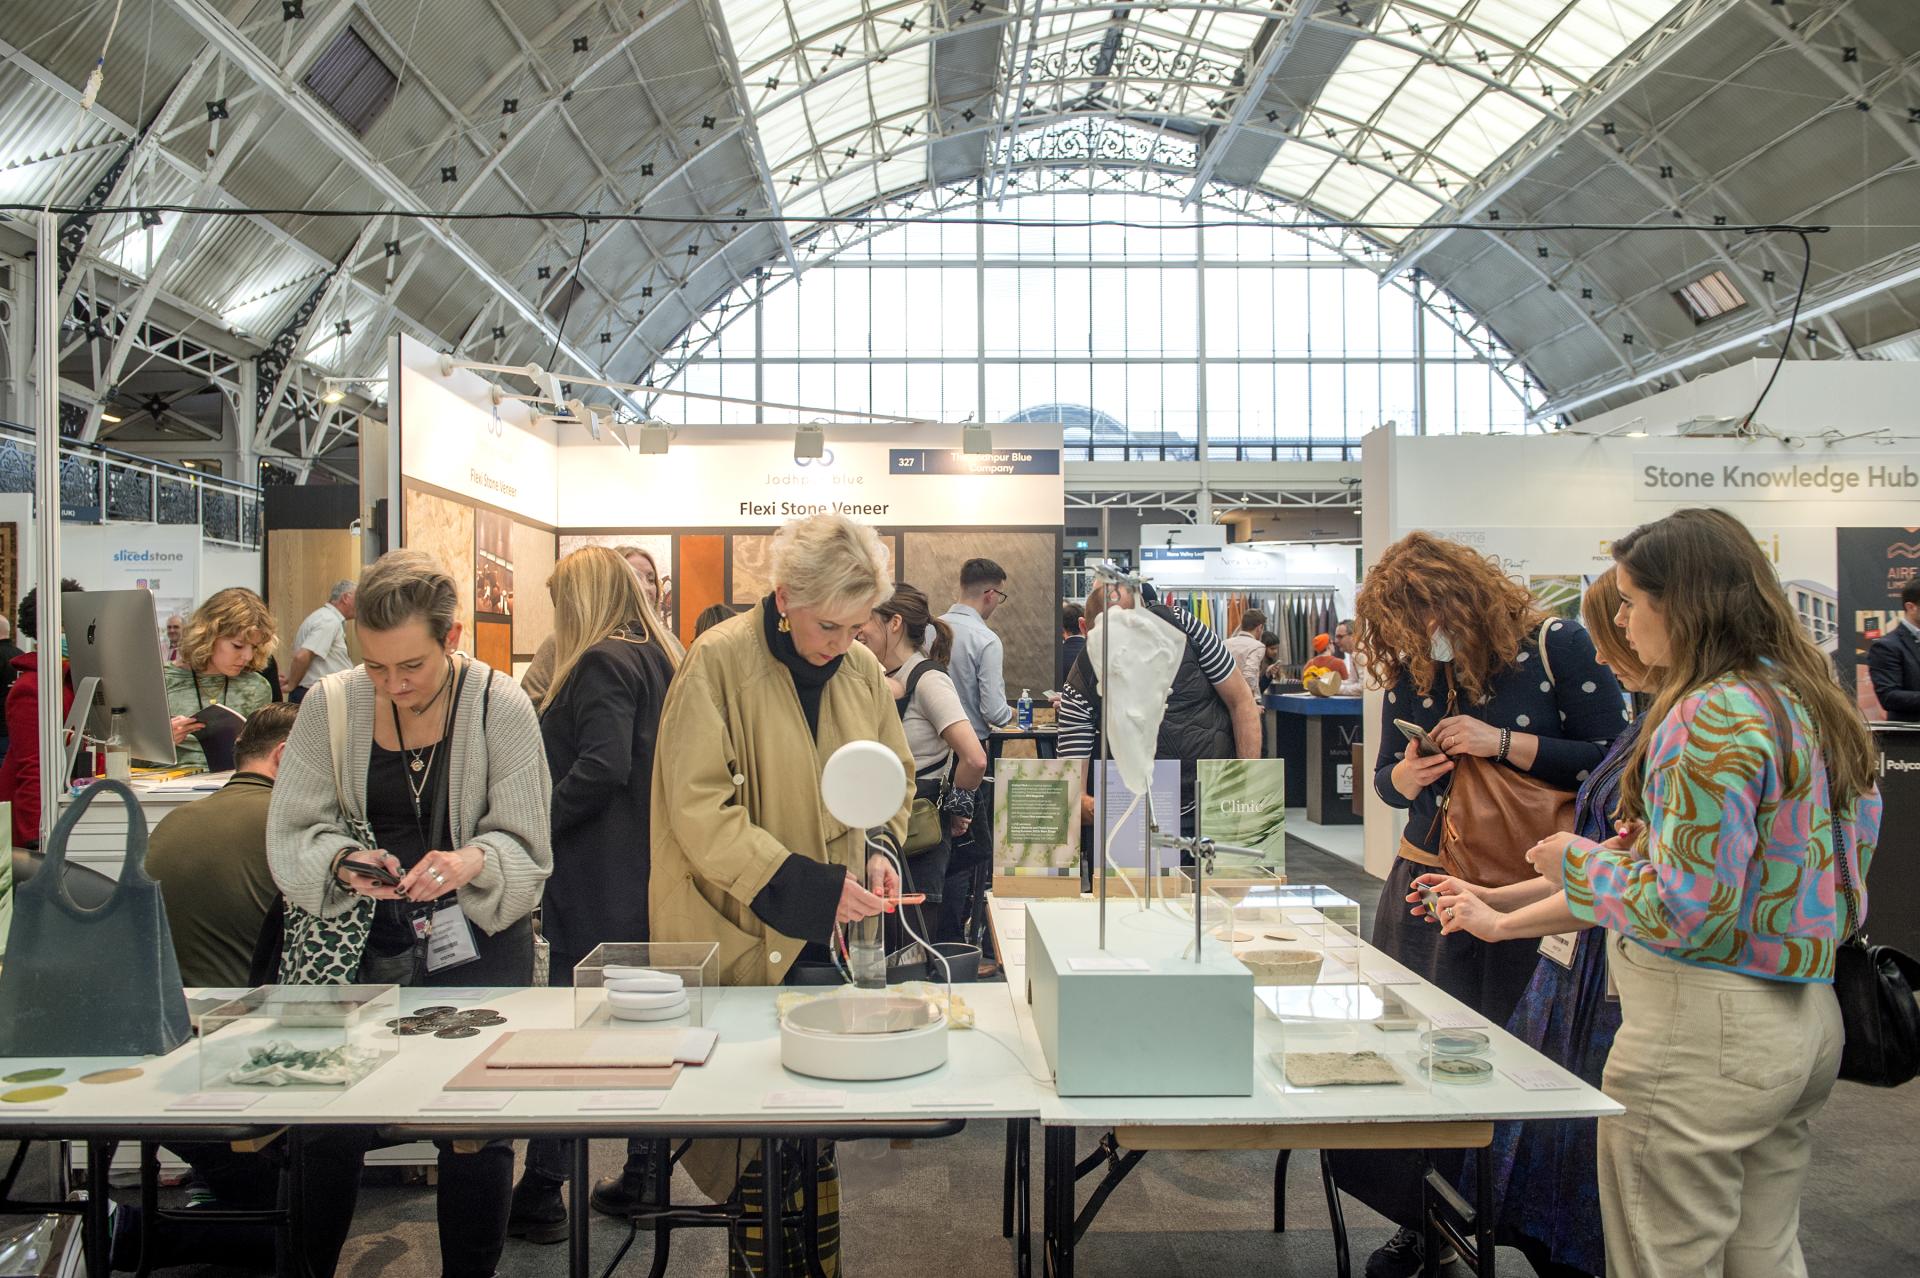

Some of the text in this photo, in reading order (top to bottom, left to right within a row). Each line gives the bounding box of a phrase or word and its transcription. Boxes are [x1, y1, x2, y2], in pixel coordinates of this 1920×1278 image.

[898, 458, 915, 467] 327
[1012, 453, 1032, 462] Blue
[1644, 465, 1919, 493] Stone Knowledge Hub
[61, 509, 76, 517] (UK)
[740, 501, 889, 515] Flexi Stone Veneer
[1220, 799, 1264, 813] Clinic
